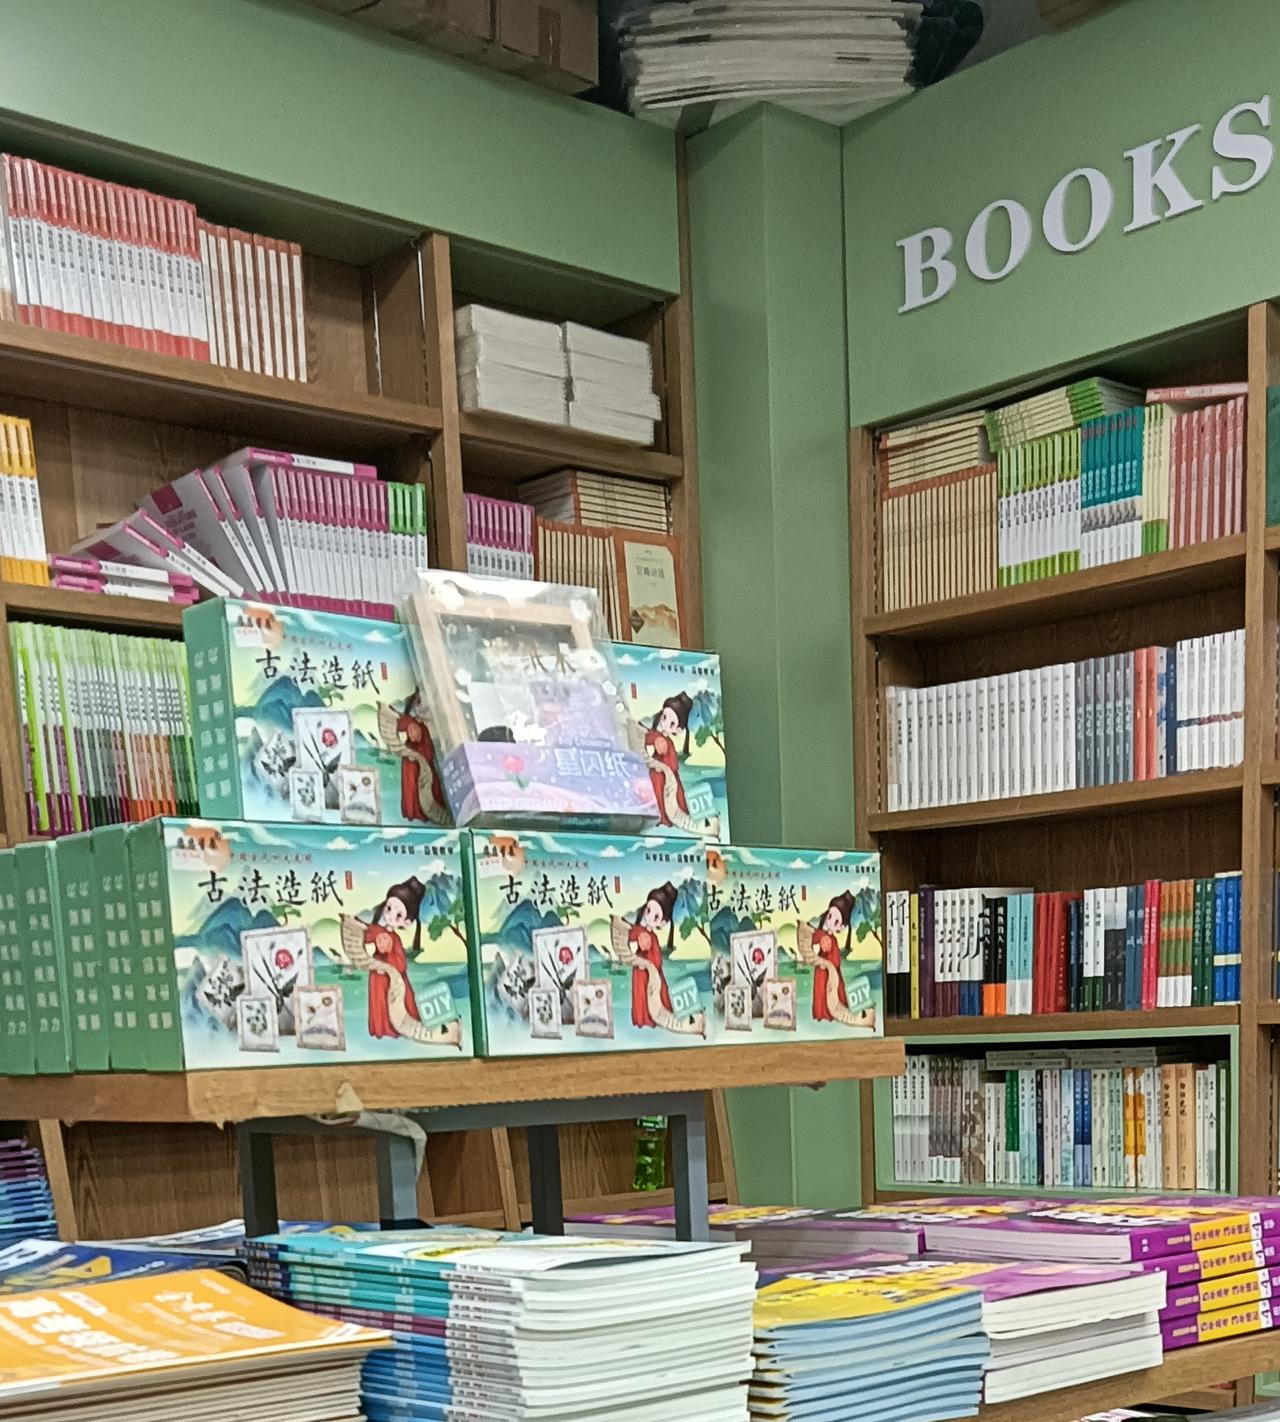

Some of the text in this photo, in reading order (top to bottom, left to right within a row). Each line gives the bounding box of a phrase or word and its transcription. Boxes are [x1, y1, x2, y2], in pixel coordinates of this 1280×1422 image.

[896, 96, 1275, 314] BOOKS
[690, 792, 714, 814] DIY
[420, 993, 452, 1020] DIY
[674, 988, 700, 1011] DIY
[849, 986, 871, 1005] DIY
